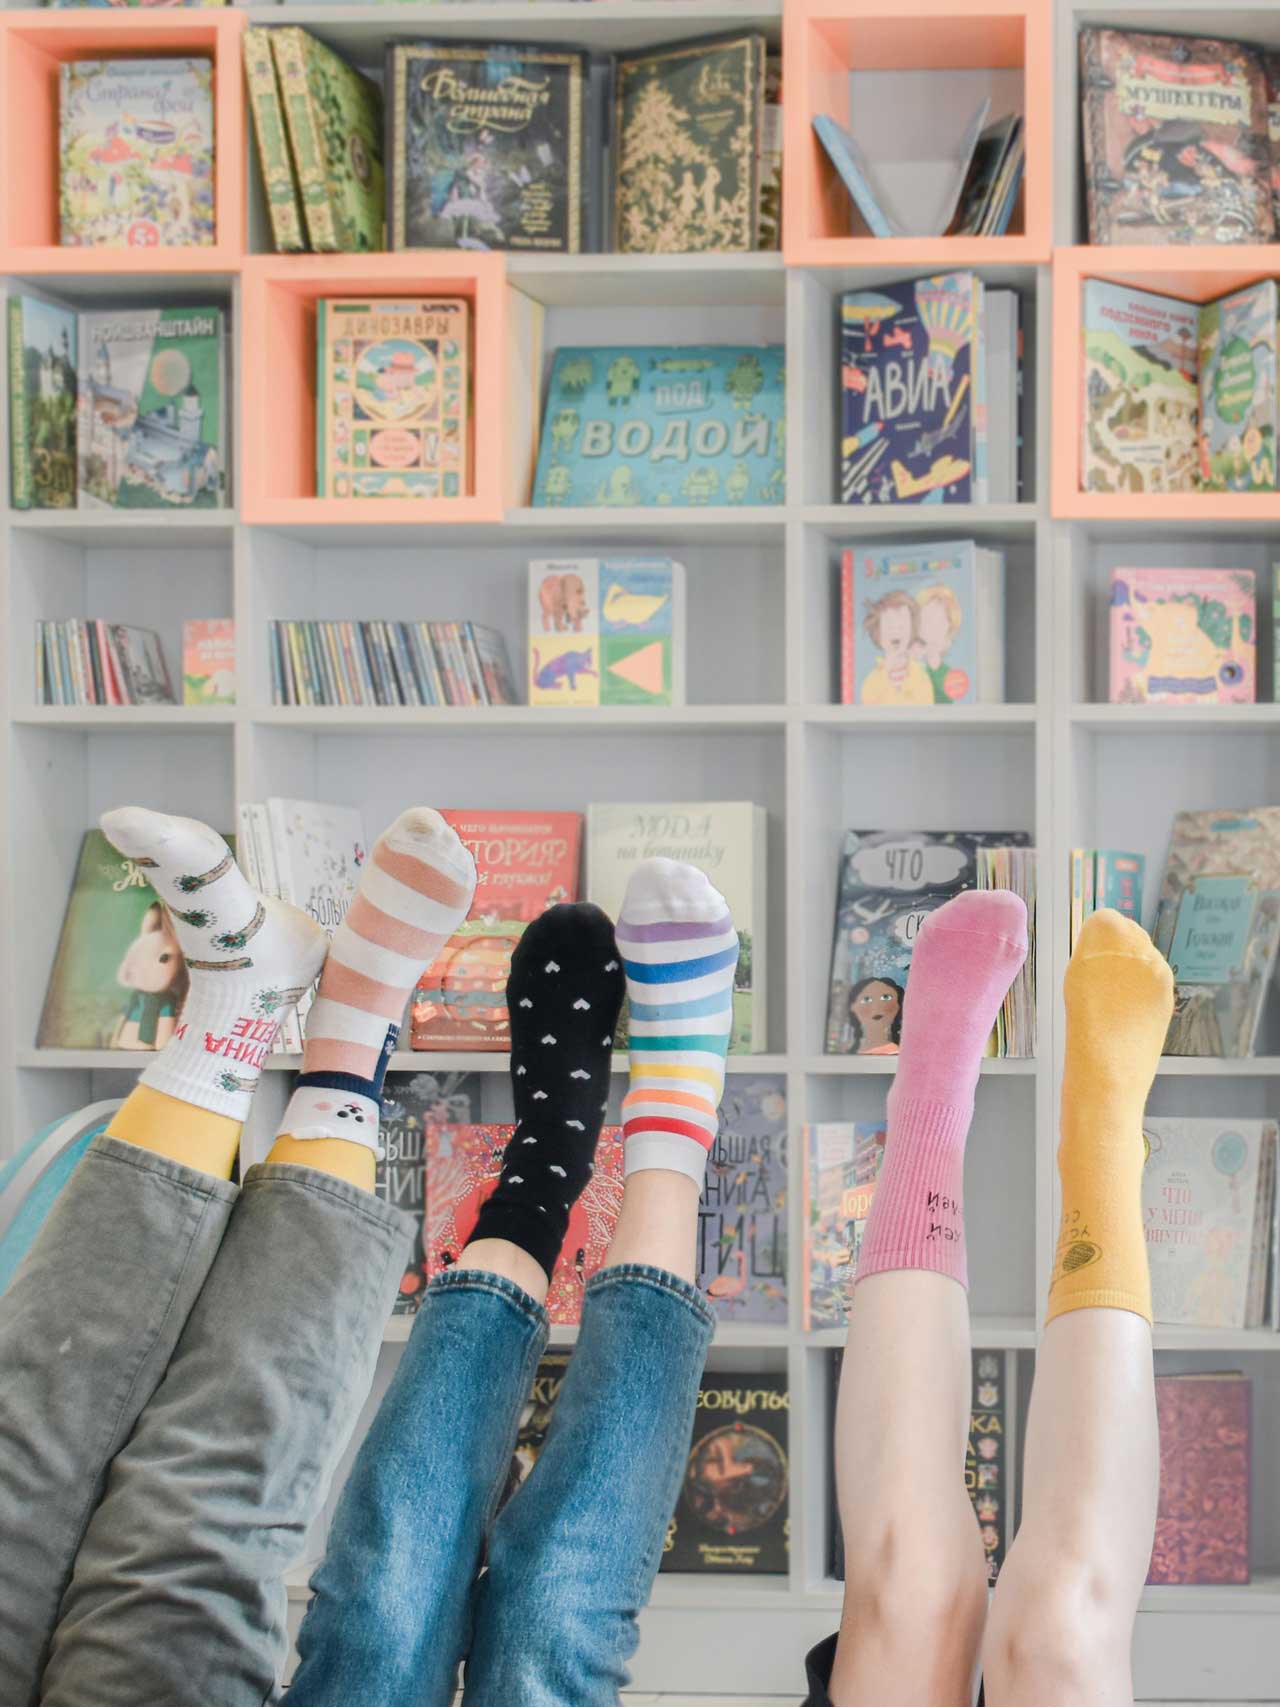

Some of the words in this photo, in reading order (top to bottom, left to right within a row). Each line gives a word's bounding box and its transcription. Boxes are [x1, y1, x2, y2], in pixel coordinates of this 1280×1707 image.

[344, 315, 450, 337] ДИНОЗАВРЫ
[655, 380, 704, 407] ПОД
[862, 354, 950, 423] АВИА
[581, 410, 768, 462] ВОДОЙ
[885, 849, 923, 881] ЧТО
[699, 1164, 770, 1207] НИГА
